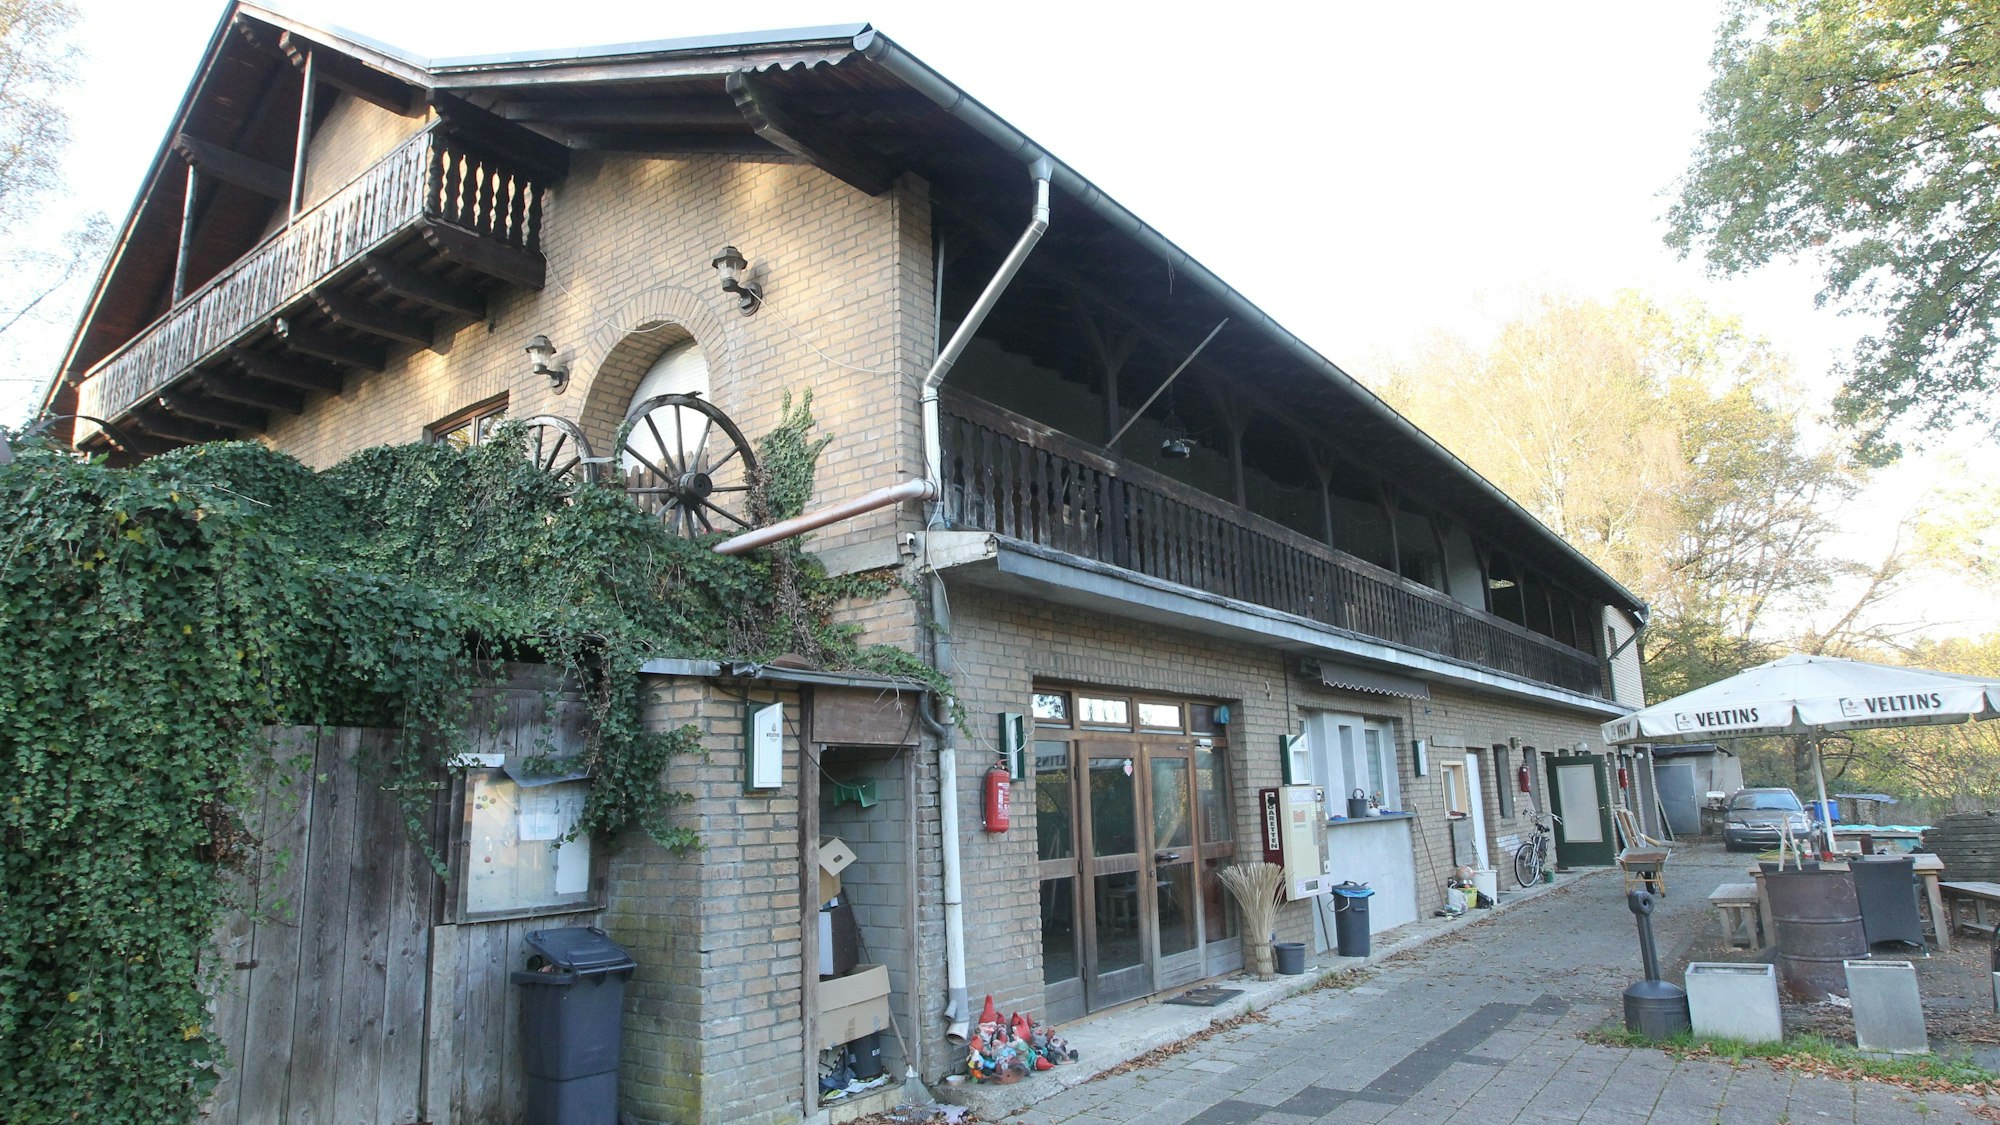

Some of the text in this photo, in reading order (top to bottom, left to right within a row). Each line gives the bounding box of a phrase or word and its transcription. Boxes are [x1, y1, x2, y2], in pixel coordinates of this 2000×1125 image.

[1864, 693, 1941, 714] VELTINS
[1695, 707, 1759, 727] VELTINS
[1267, 793, 1278, 849] CGARETTEN
